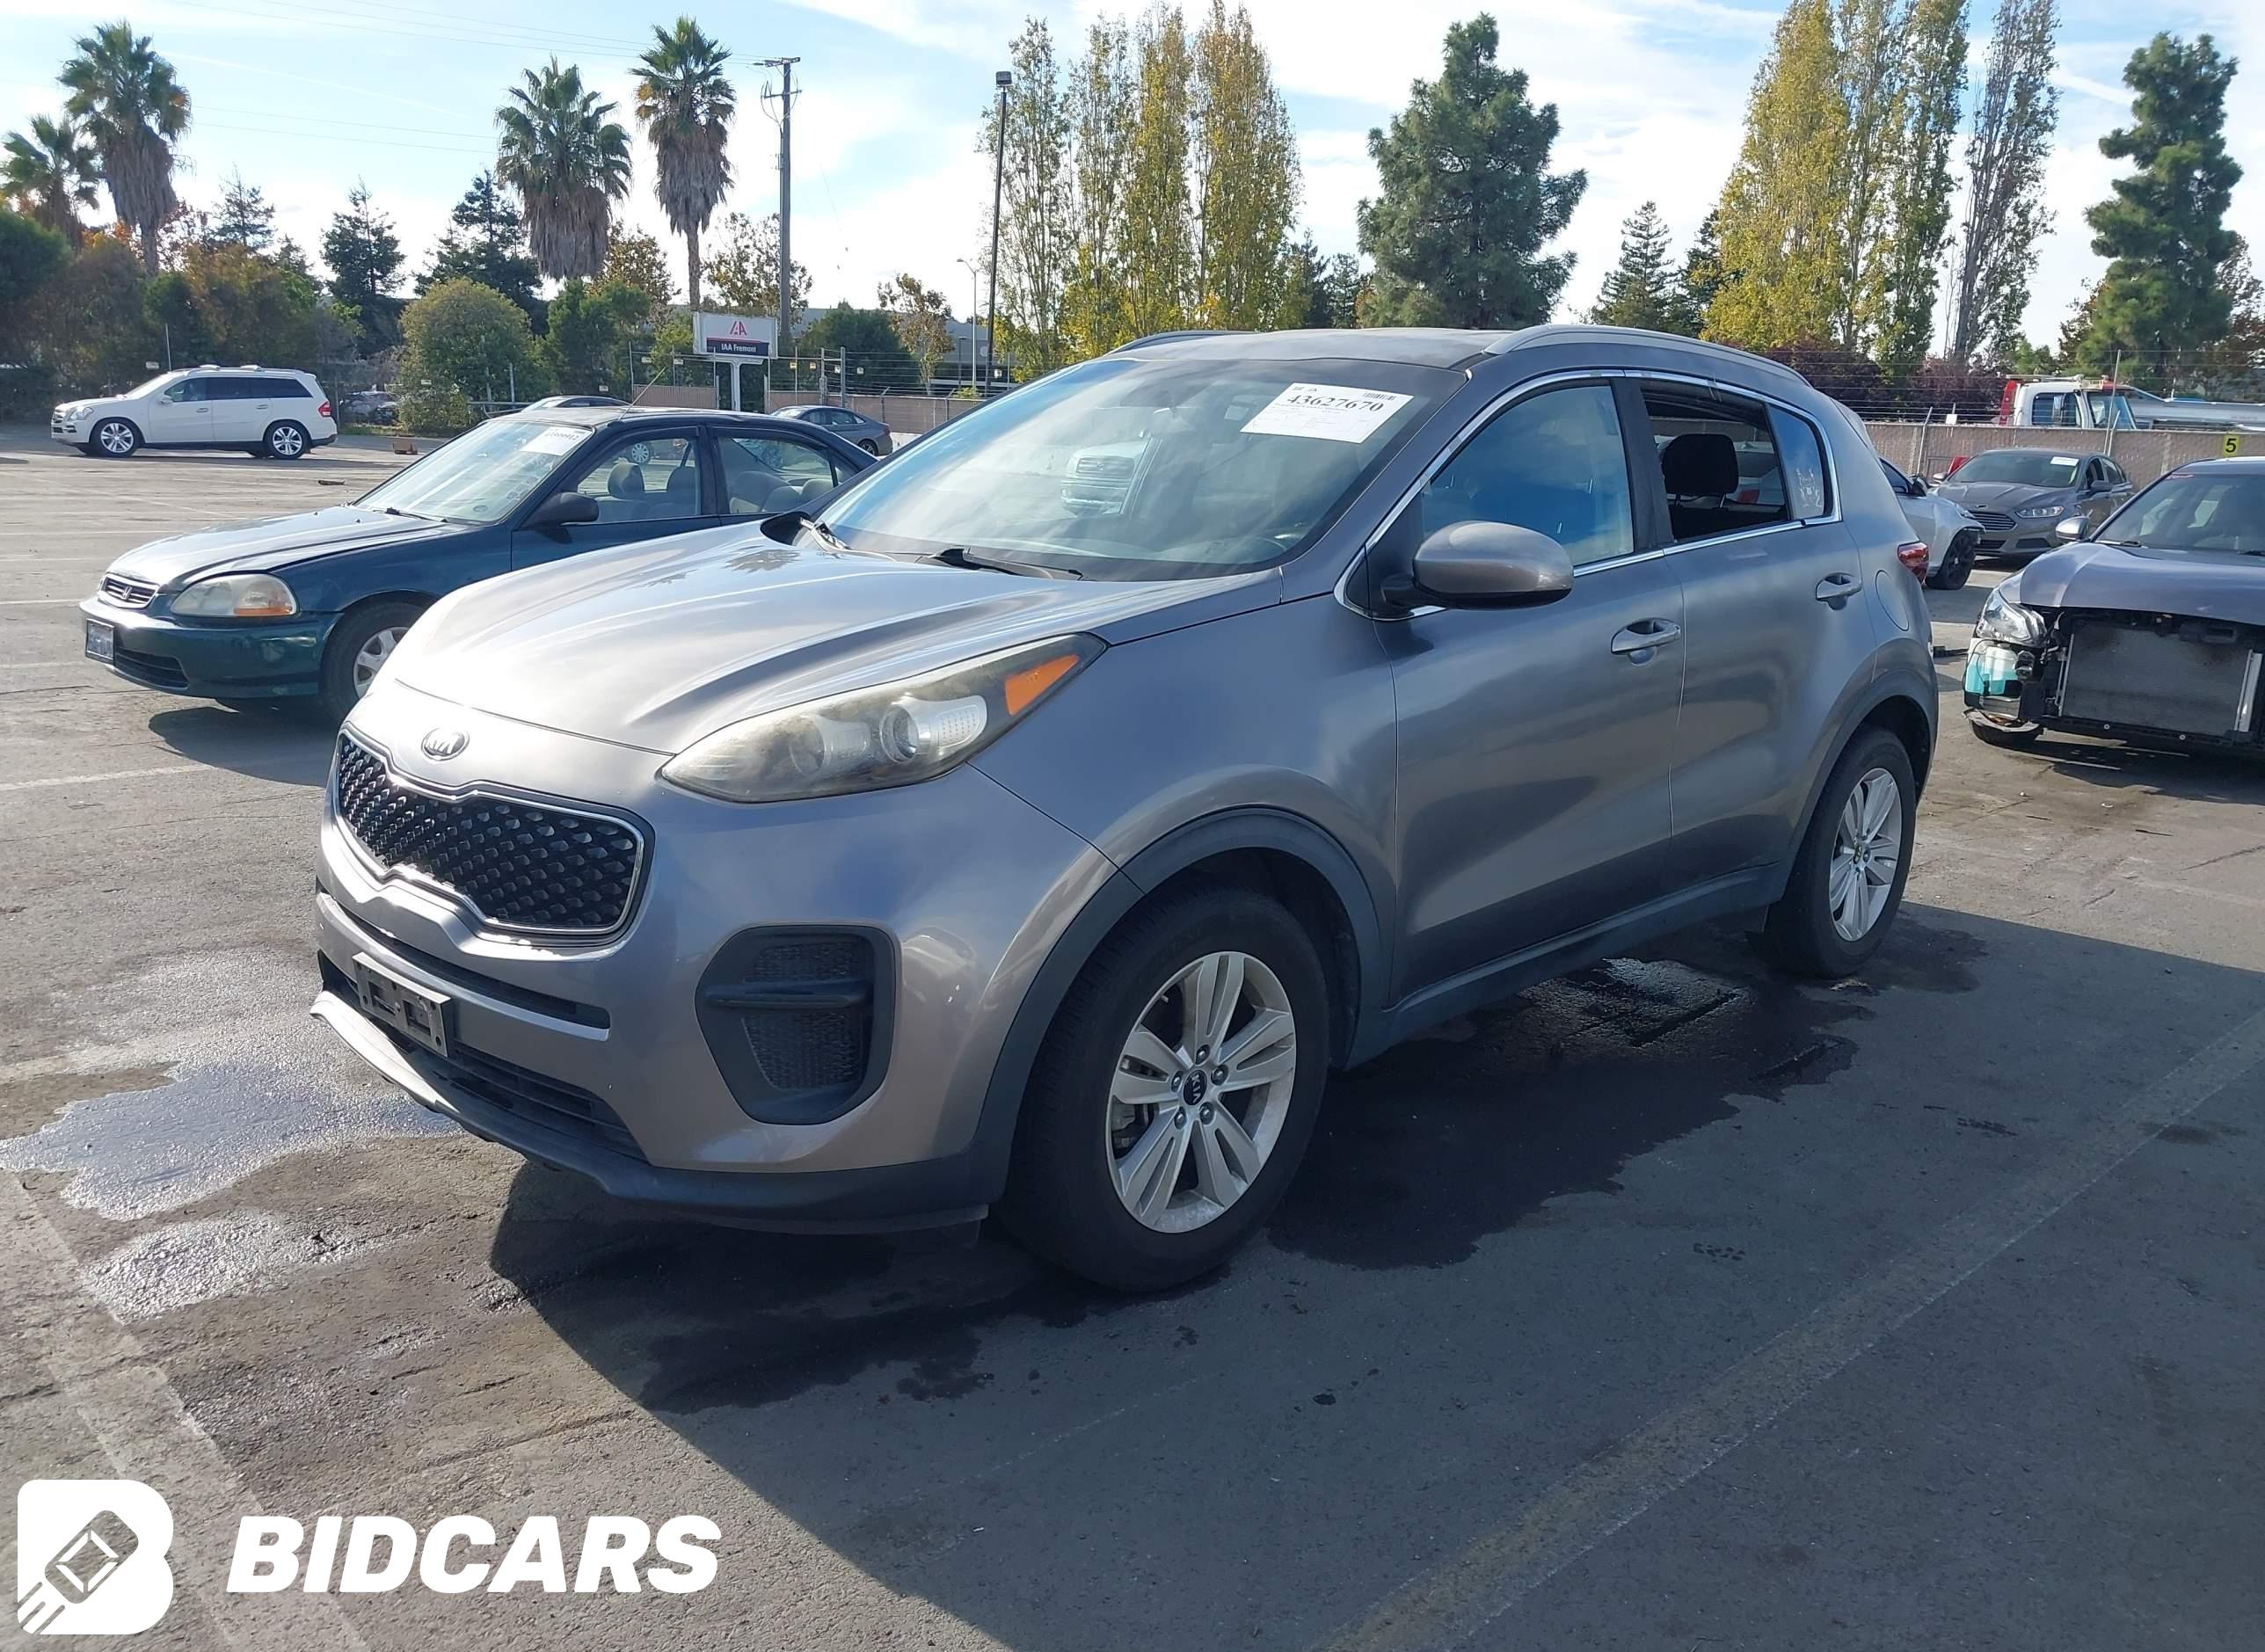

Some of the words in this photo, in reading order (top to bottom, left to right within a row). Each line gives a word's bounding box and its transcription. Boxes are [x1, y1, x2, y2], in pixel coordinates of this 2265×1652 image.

[721, 343, 732, 352] IAA
[733, 344, 757, 353] Fremont
[1286, 395, 1385, 412] 43627670
[2225, 438, 2238, 453] 5
[1191, 1073, 1201, 1103] KIA
